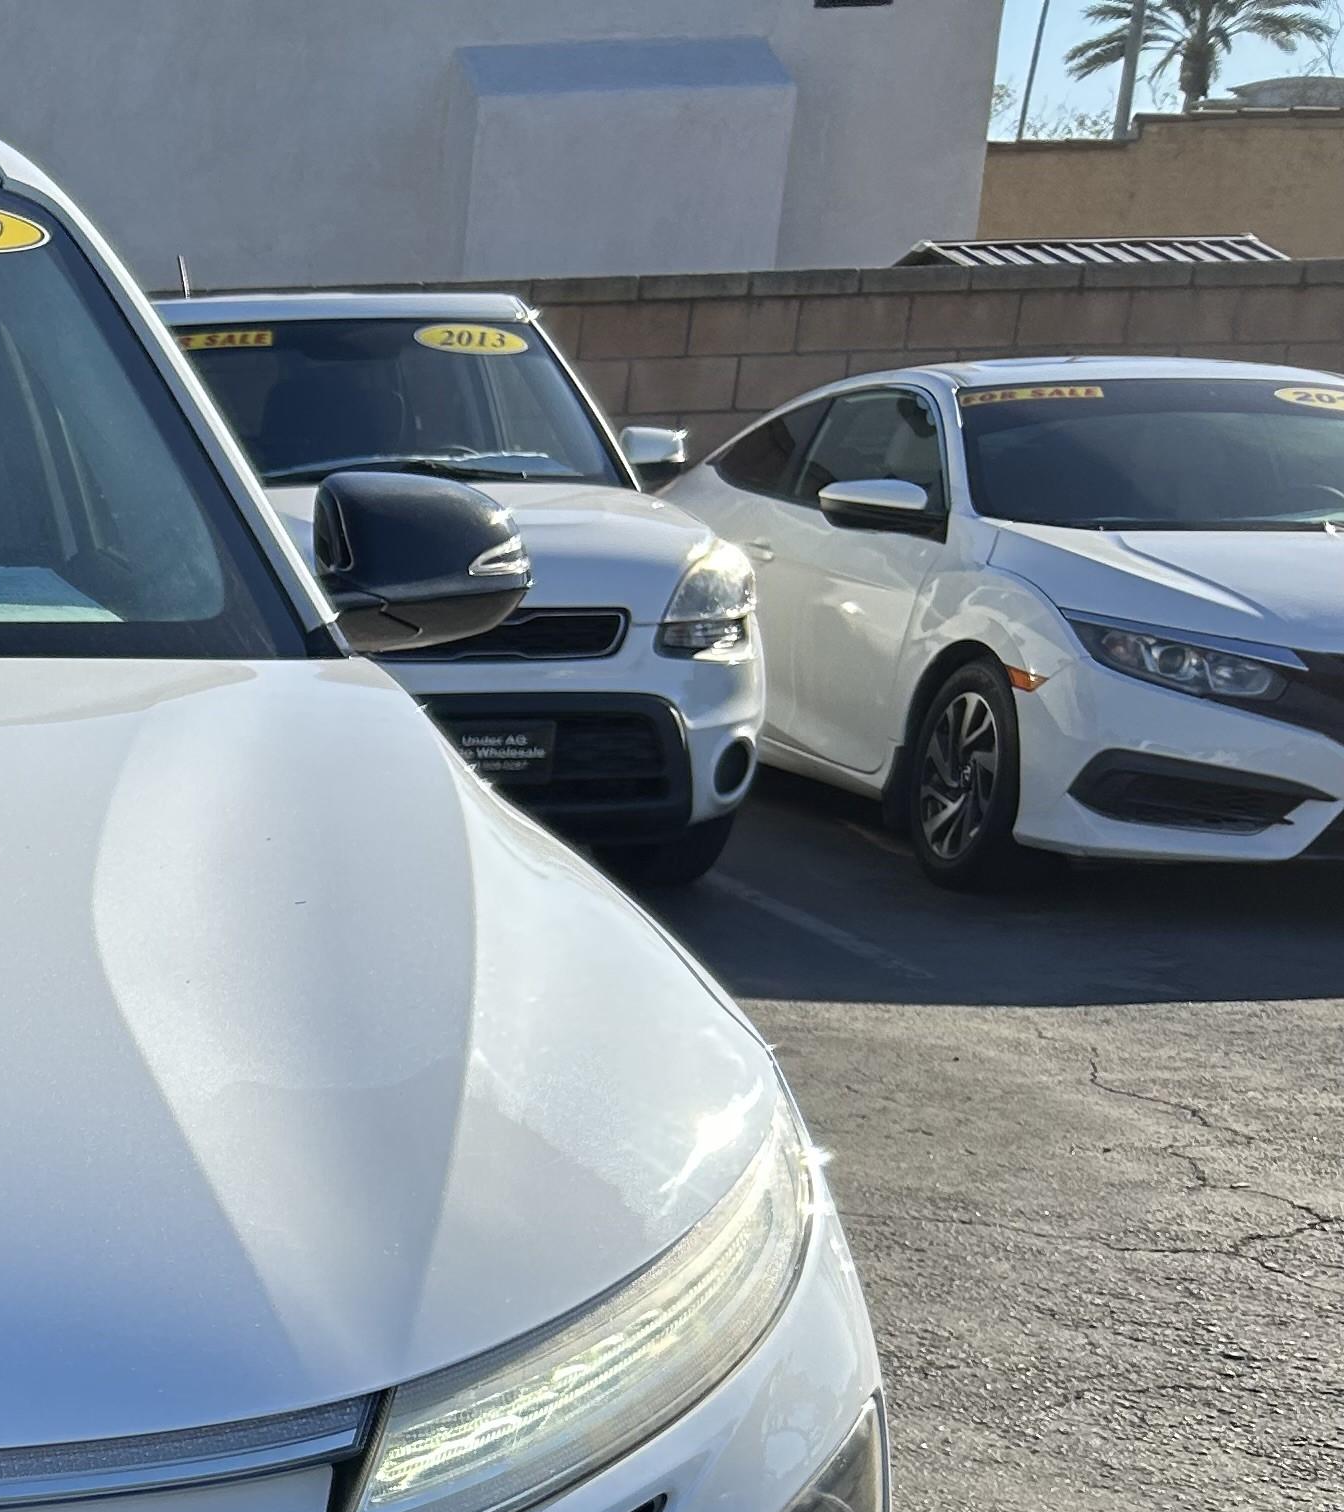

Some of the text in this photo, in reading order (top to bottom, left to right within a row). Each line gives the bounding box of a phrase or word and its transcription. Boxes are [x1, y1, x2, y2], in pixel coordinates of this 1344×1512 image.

[205, 332, 269, 346] SALE
[439, 329, 507, 348] 2013
[961, 387, 1099, 405] FOR SALE
[1292, 391, 1344, 404] 20
